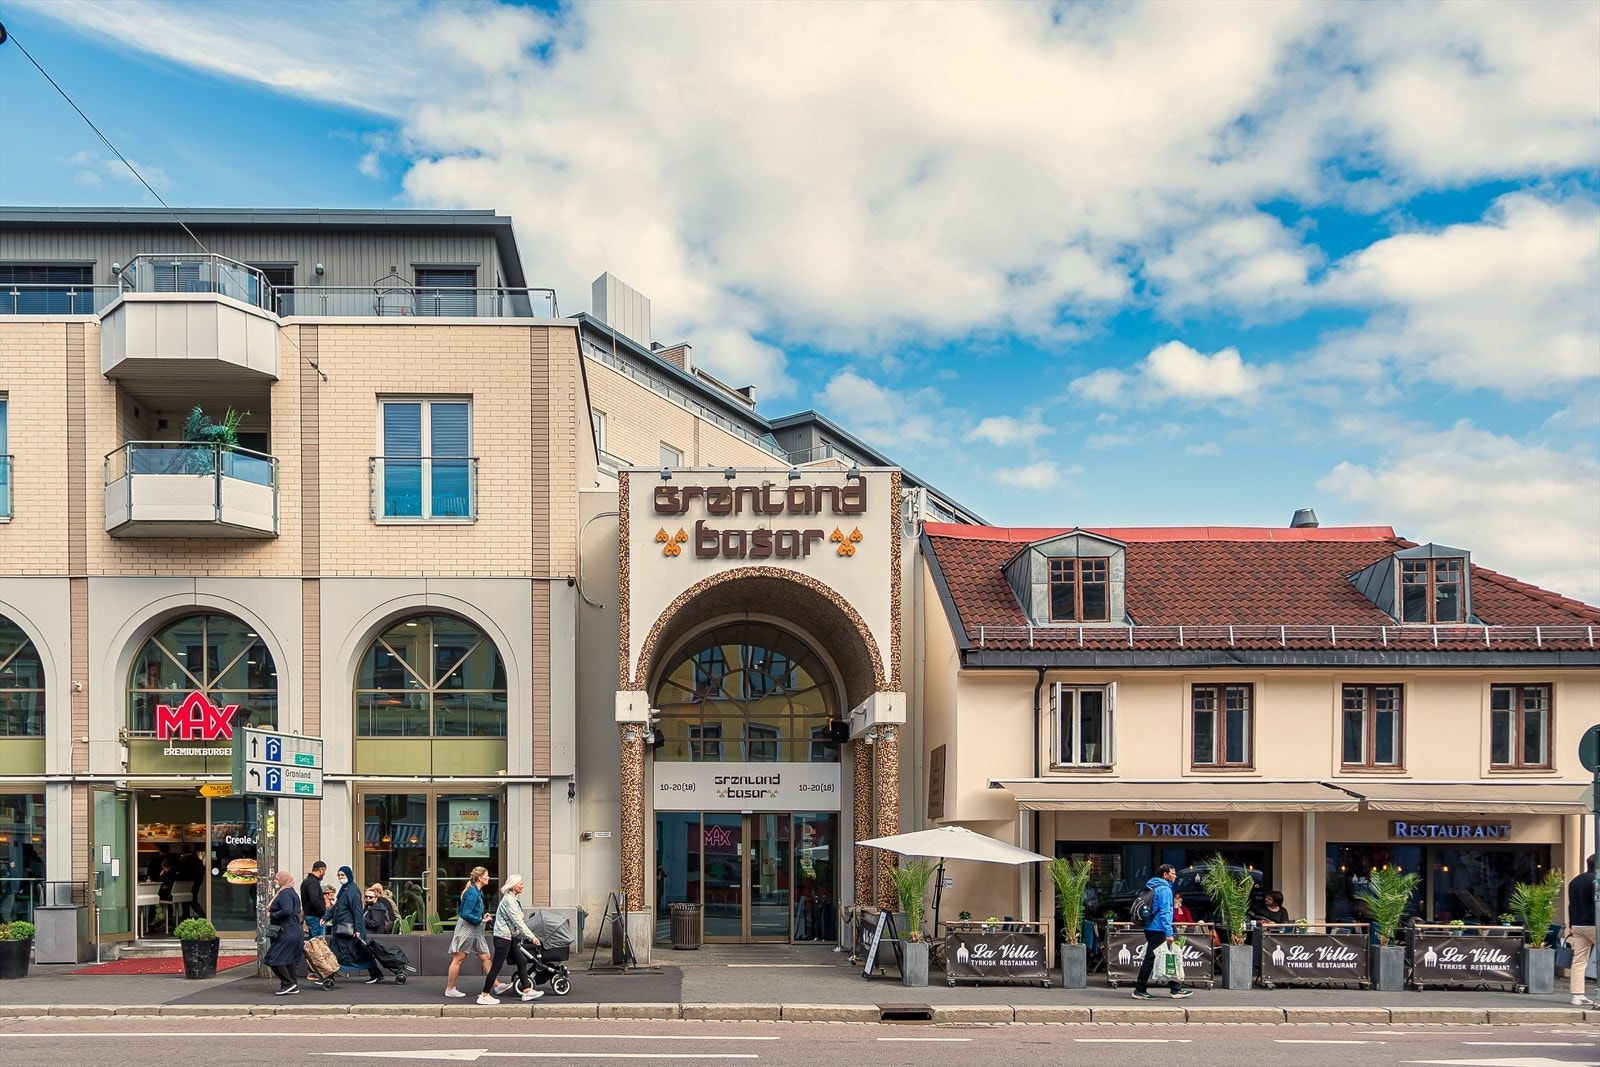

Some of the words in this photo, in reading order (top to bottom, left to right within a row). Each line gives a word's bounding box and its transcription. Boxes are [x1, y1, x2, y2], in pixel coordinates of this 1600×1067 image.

[695, 520, 825, 557] basar
[156, 689, 240, 741] MAX
[660, 782, 696, 792] 10-20(18)
[727, 787, 768, 798] basar
[798, 784, 835, 793] 10-20(18)
[225, 835, 251, 844] Creole
[971, 943, 997, 959] La
[999, 943, 1039, 959] Villa
[1286, 945, 1314, 961] La
[1315, 945, 1359, 961] Villa
[1439, 946, 1468, 962] La
[1469, 947, 1511, 963] Villa
